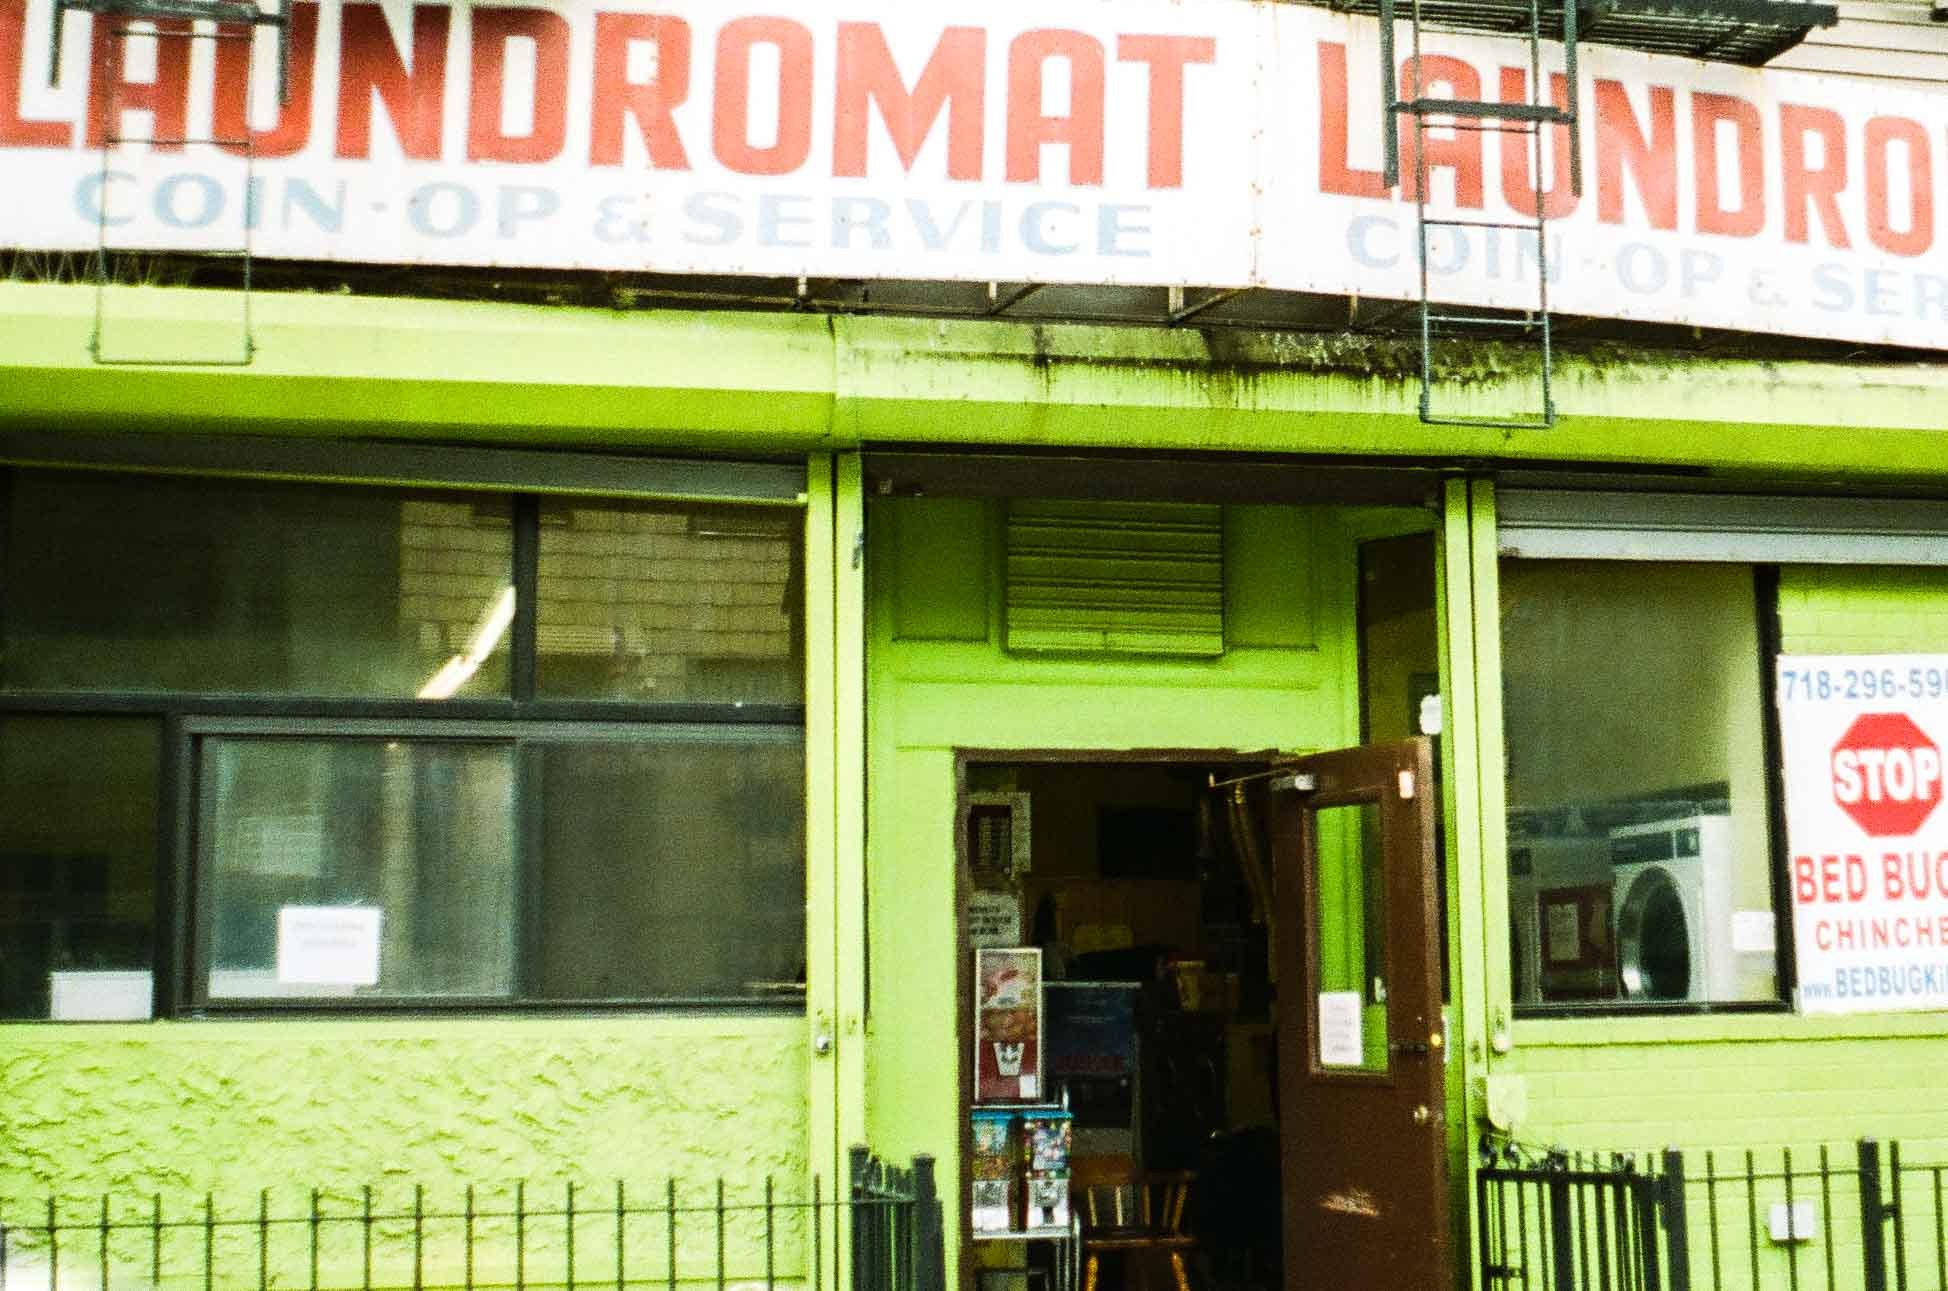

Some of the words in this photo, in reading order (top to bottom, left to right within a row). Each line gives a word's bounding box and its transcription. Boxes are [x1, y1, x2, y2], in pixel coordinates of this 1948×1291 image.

[0, 0, 1216, 189] LAUNDROMAT
[1317, 41, 1948, 258] LAUNDRO
[73, 169, 561, 240] COIN-OP
[592, 195, 652, 245] &
[680, 191, 1153, 258] SERVICE
[1783, 668, 1948, 700] 718-296-59
[1833, 747, 1940, 804] STOP
[1795, 854, 1869, 904] BED
